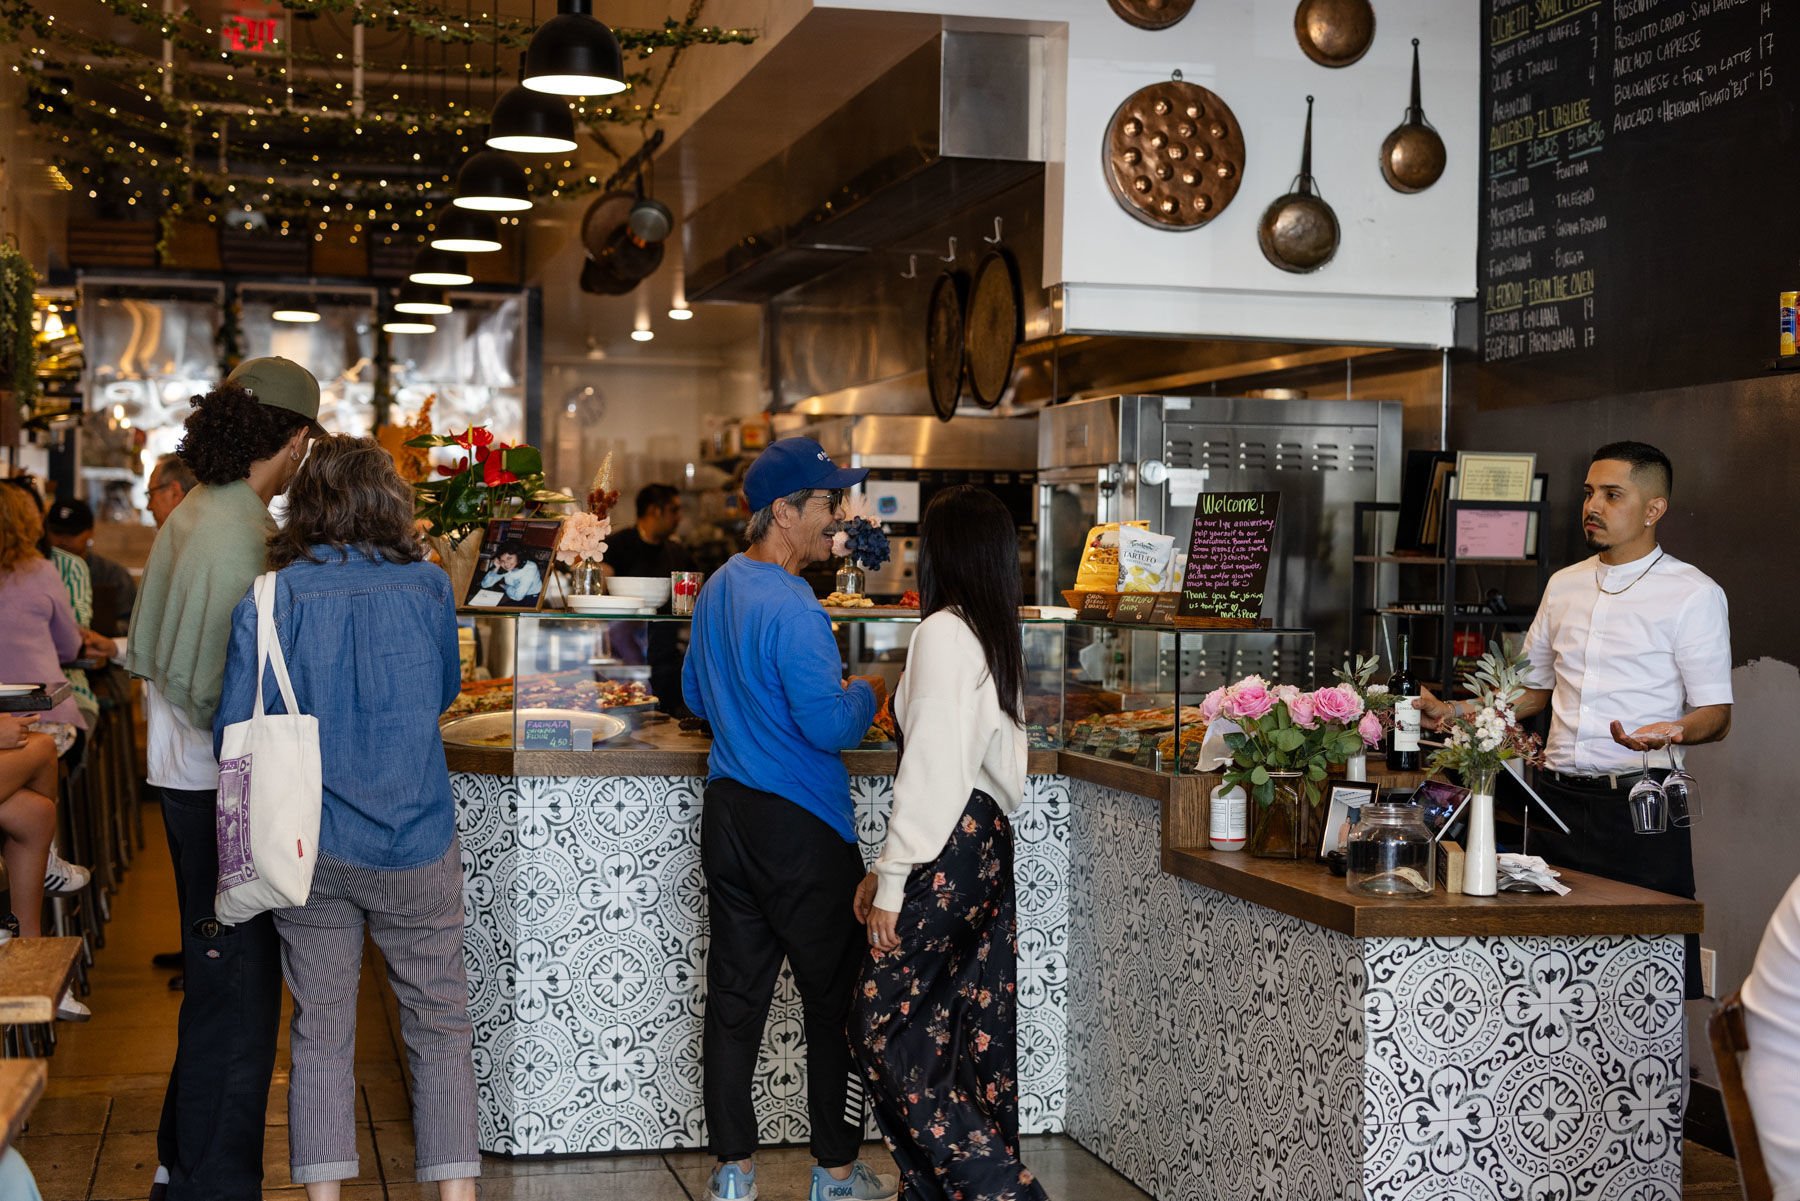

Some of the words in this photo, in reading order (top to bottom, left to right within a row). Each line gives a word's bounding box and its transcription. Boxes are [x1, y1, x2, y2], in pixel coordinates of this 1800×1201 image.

[1591, 11, 1598, 30] 9
[1760, 1, 1772, 25] 14
[1547, 20, 1581, 43] WAFFLE
[1589, 36, 1598, 58] 7
[1656, 29, 1702, 61] CAPRESE
[1759, 32, 1774, 59] 17
[1588, 65, 1596, 87] 4
[1613, 73, 1670, 106] BOLOGNESE
[1682, 65, 1704, 86] FIOR
[1705, 65, 1718, 76] DI
[1720, 47, 1752, 71] LATTE
[1759, 66, 1774, 90] 15
[1613, 106, 1654, 134] AVOCADO
[1699, 88, 1730, 111] TOMATO
[1555, 160, 1590, 181] FONTINA
[1529, 278, 1551, 302] FROM
[1552, 275, 1569, 298] THE
[1570, 269, 1594, 294] OVEN
[1583, 297, 1595, 320] 19
[1584, 327, 1596, 348] 17
[1202, 493, 1265, 515] Welcome!
[1194, 518, 1203, 527] To
[1209, 529, 1237, 540] yourself
[1123, 550, 1157, 565] TARTUFO
[1188, 562, 1201, 574] Any
[1214, 580, 1230, 590] paid
[1119, 603, 1139, 611] CHIPS
[1121, 595, 1154, 604] TARTUFO
[1183, 590, 1208, 600] Thank
[1211, 592, 1227, 605] you
[1229, 590, 1240, 600] for
[1239, 591, 1264, 606] joining
[1200, 601, 1231, 613] tonight
[1135, 611, 1142, 620] 6
[526, 720, 569, 729] FARINATA
[828, 1186, 853, 1198] HOKA
